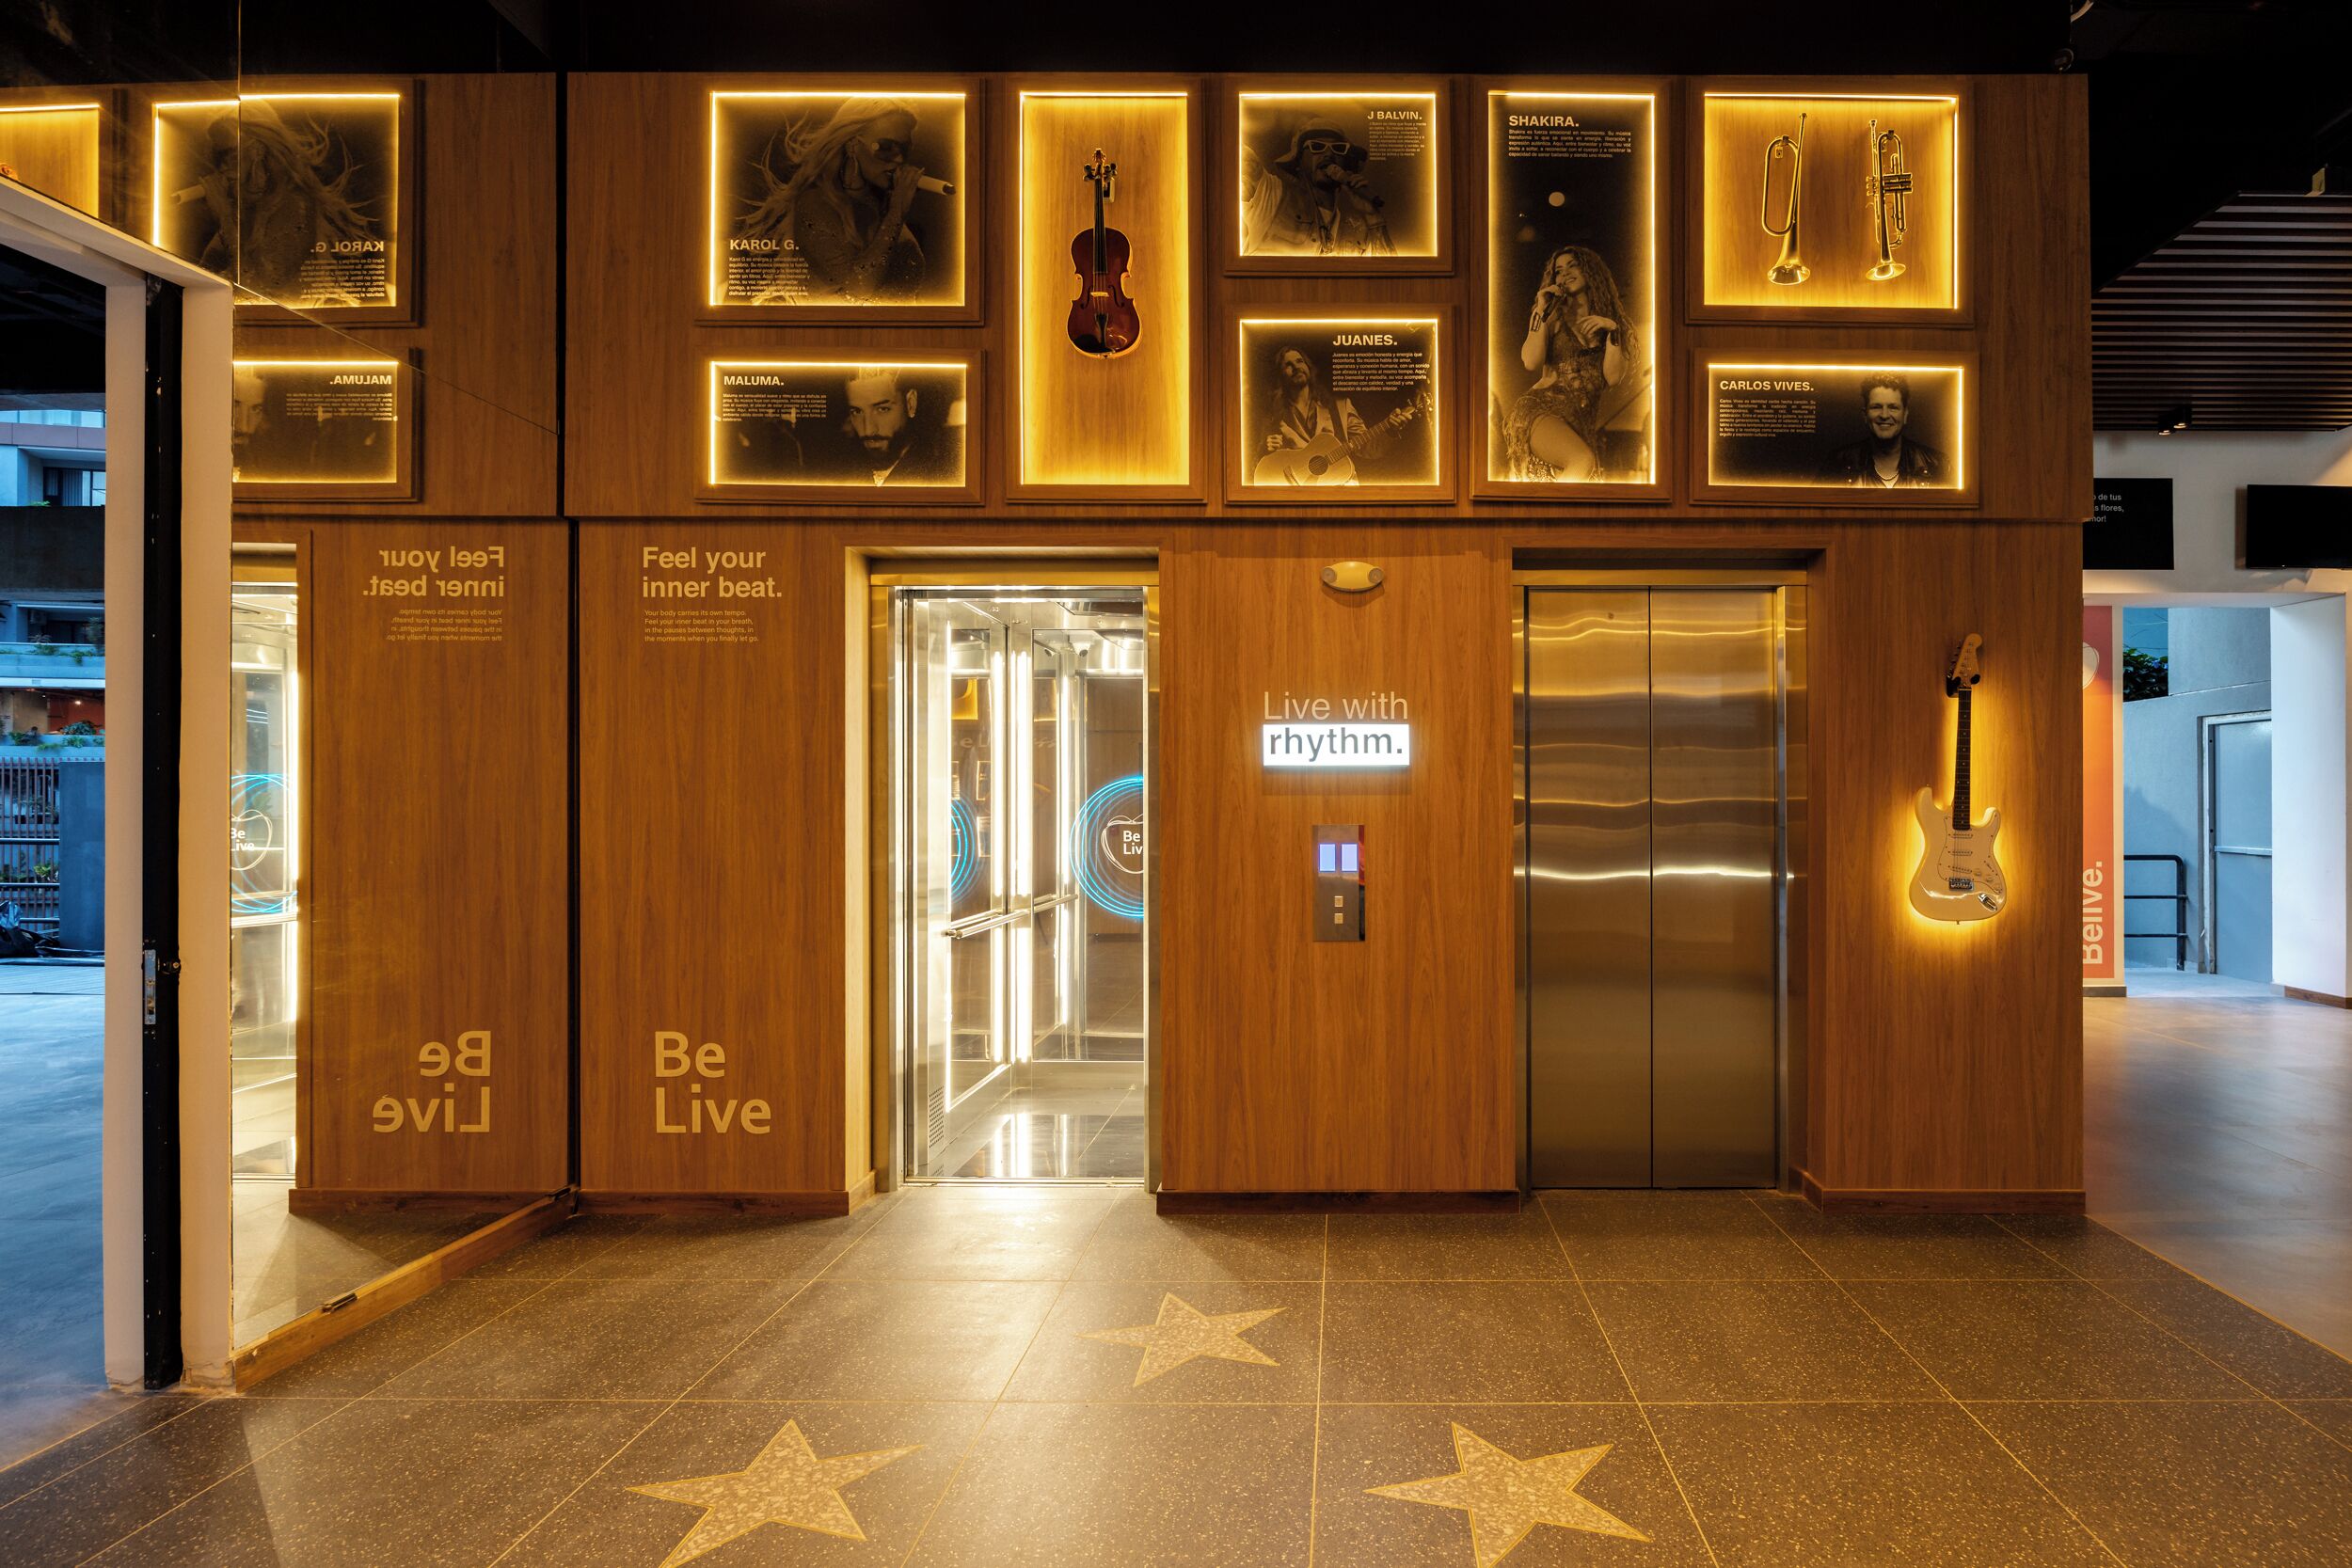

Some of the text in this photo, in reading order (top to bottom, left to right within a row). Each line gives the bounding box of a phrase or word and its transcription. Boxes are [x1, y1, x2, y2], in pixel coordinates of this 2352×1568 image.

[1367, 111, 1422, 120] J BALVIN.
[1509, 115, 1580, 127] SHAKIRA.
[730, 239, 800, 250] KAROL G.
[1332, 334, 1398, 346] JUANES.
[723, 375, 785, 386] MALUMA.
[1720, 380, 1814, 391] CARLOS VIVES.
[643, 546, 767, 575] Feel your
[643, 576, 783, 598] inner beat.
[719, 635, 739, 643] finally
[1263, 690, 1409, 721] Live with
[1270, 727, 1403, 763] rhythm.
[1122, 830, 1141, 843] Be
[1122, 842, 1144, 855] Liv
[655, 1031, 726, 1079] Be
[656, 1083, 772, 1134] Live
